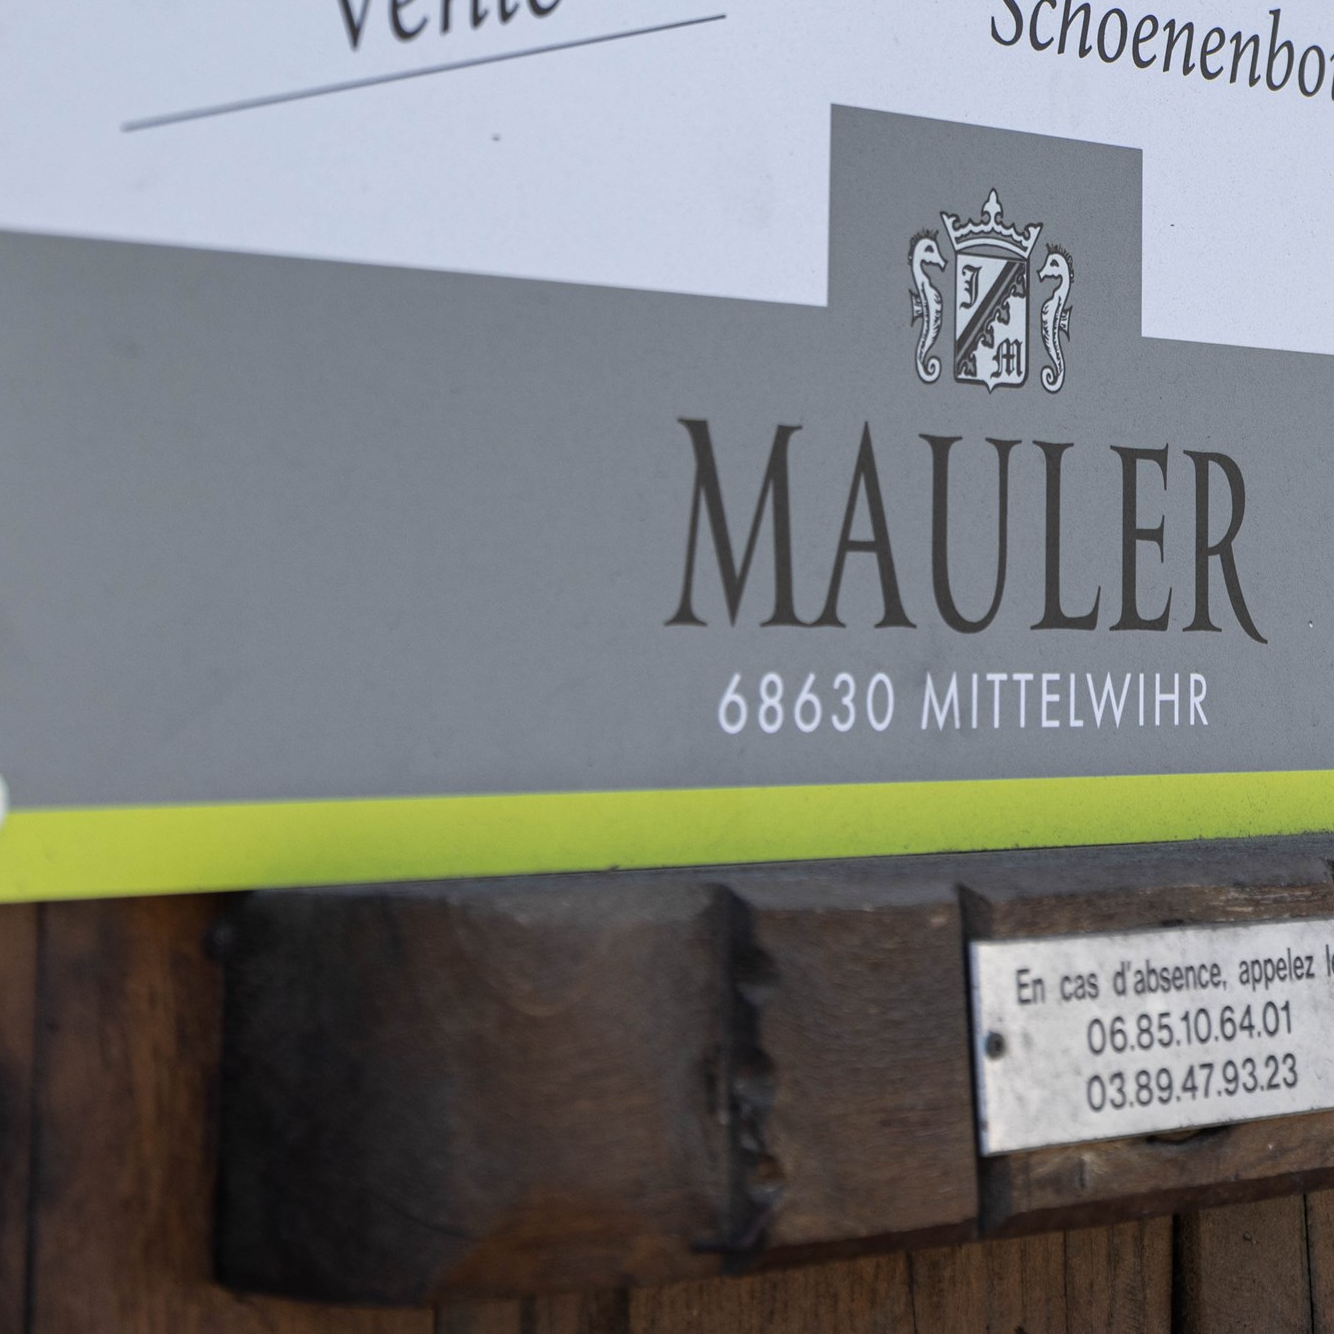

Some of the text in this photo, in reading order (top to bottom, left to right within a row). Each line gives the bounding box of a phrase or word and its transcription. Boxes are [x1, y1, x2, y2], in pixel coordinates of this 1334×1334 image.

[663, 416, 1269, 645] MAULER
[718, 671, 1210, 735] 68630 MITTELWIHR
[1015, 968, 1045, 1006] En
[1061, 971, 1099, 1003] cas
[1112, 957, 1228, 997] d'absence,
[1238, 946, 1315, 992] appelez
[1086, 999, 1294, 1056] 06.85.10.64.01
[1086, 1051, 1299, 1113] 03.89.47.93.23
